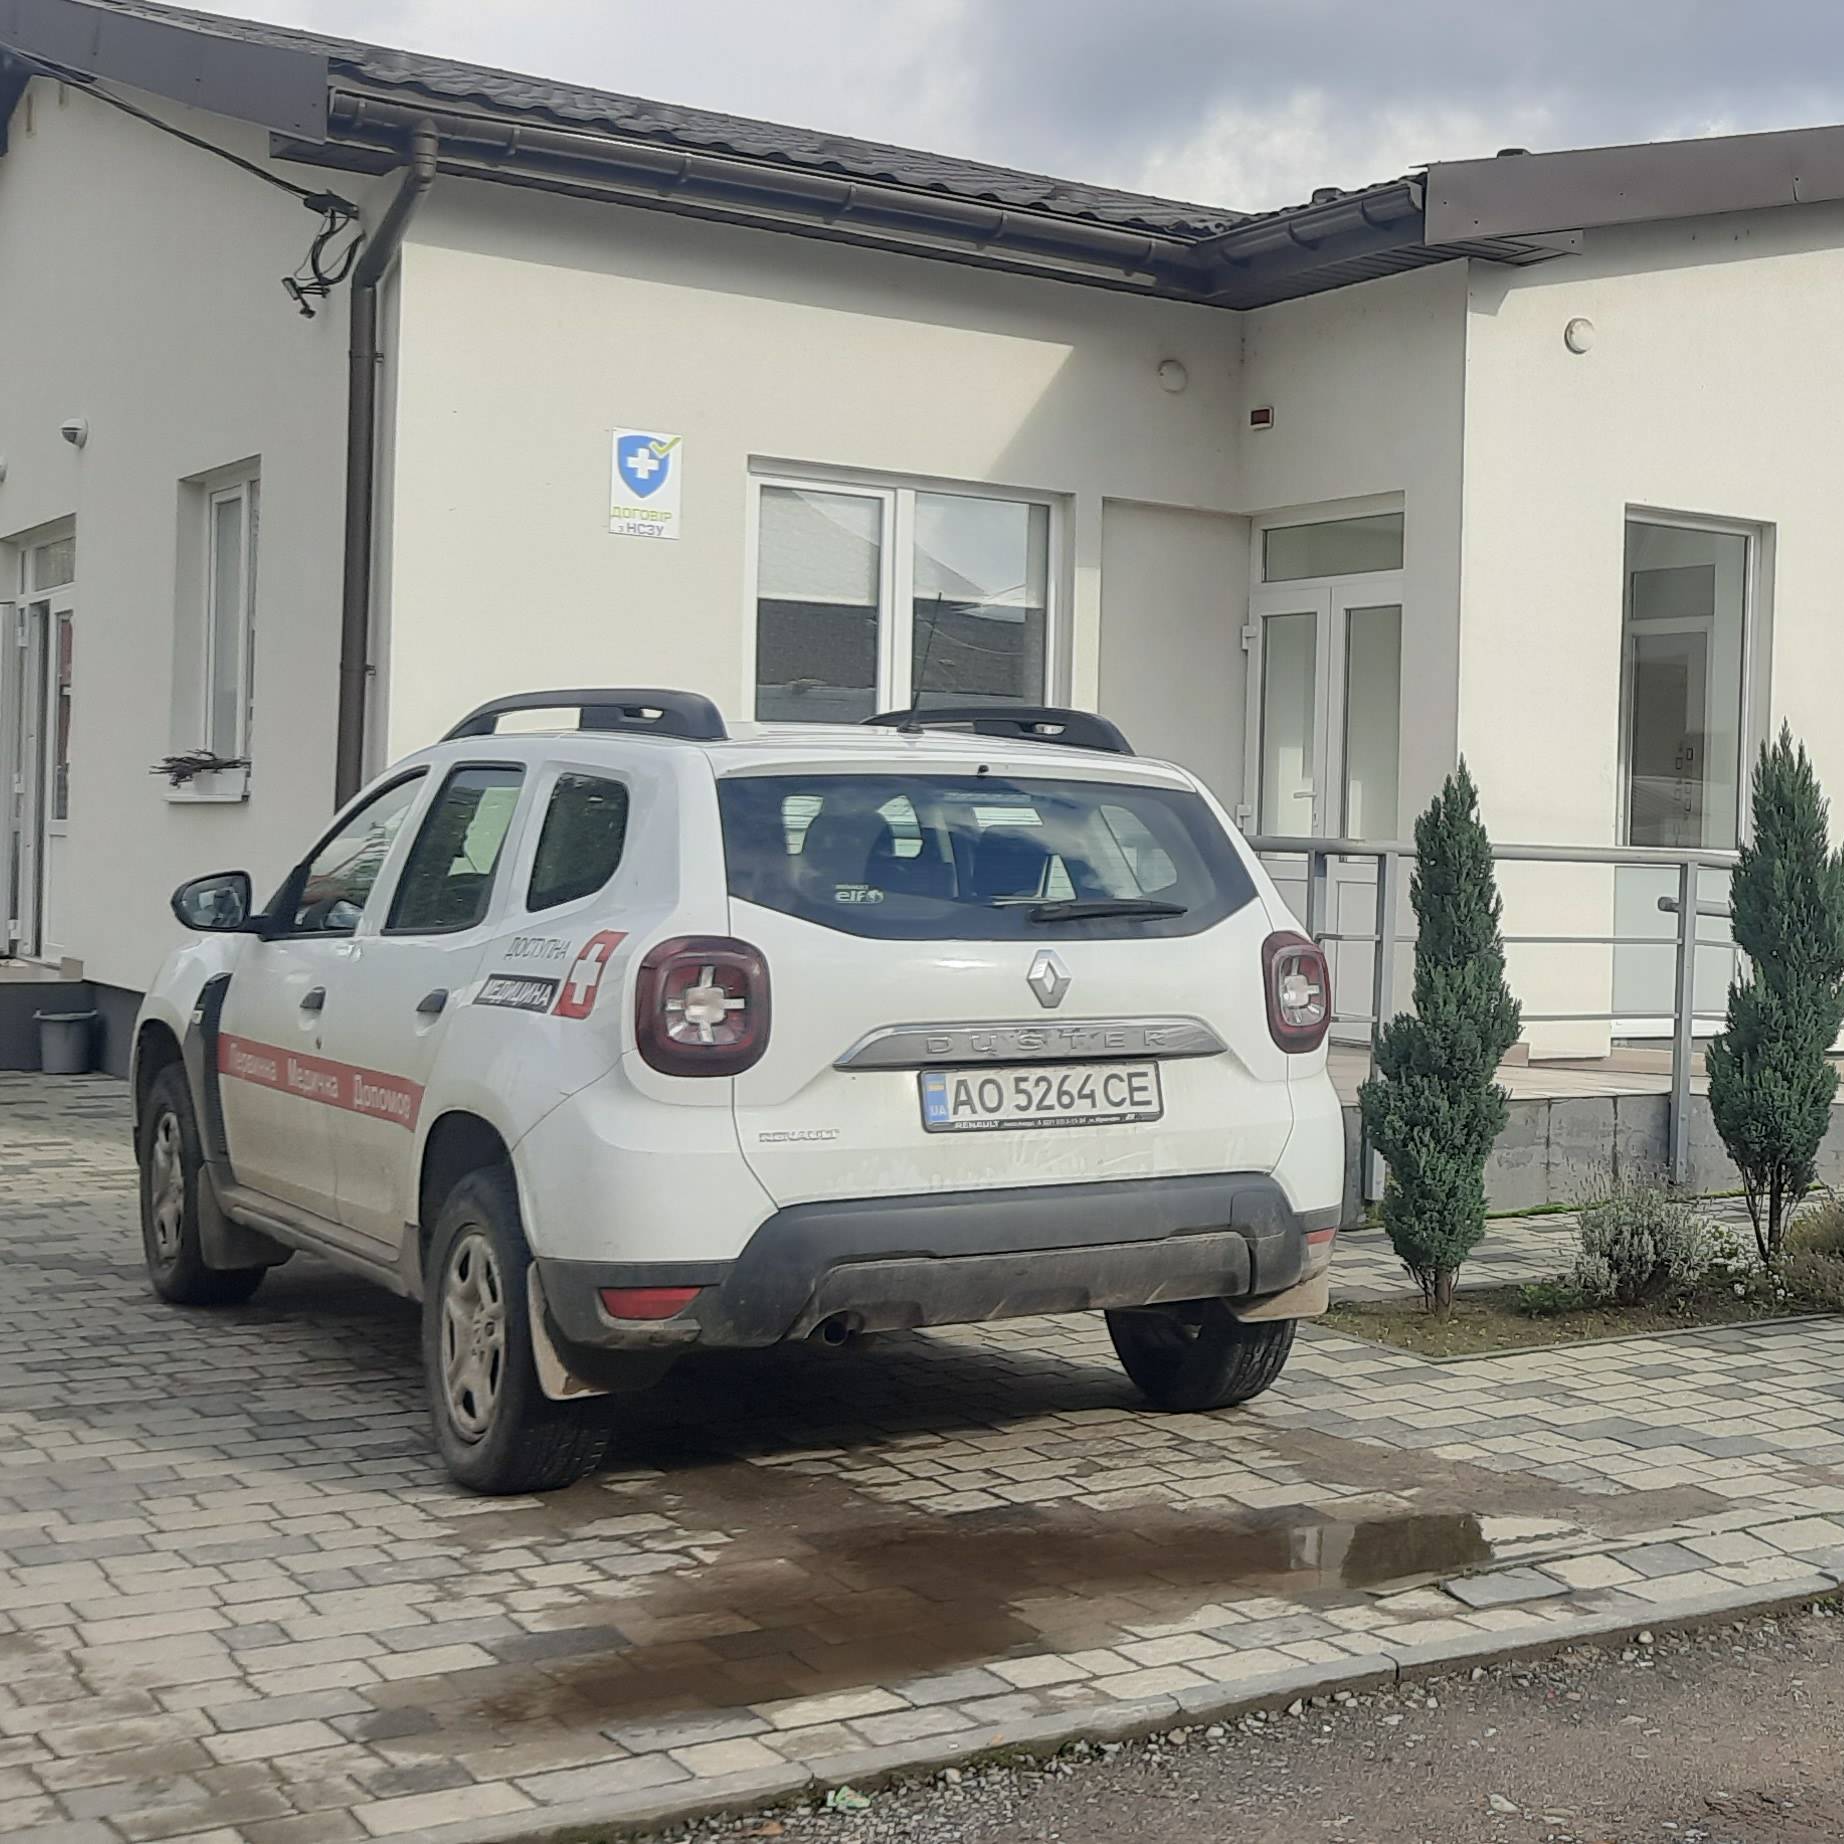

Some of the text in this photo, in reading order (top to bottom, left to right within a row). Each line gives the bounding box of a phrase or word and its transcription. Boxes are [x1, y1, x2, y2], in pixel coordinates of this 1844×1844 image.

[609, 506, 673, 522] ДОГОВІР
[626, 522, 664, 536] НСЗУ
[926, 1029, 1167, 1054] DUSTER
[952, 1071, 1153, 1116] AO 5264 CE
[930, 1105, 947, 1117] UA
